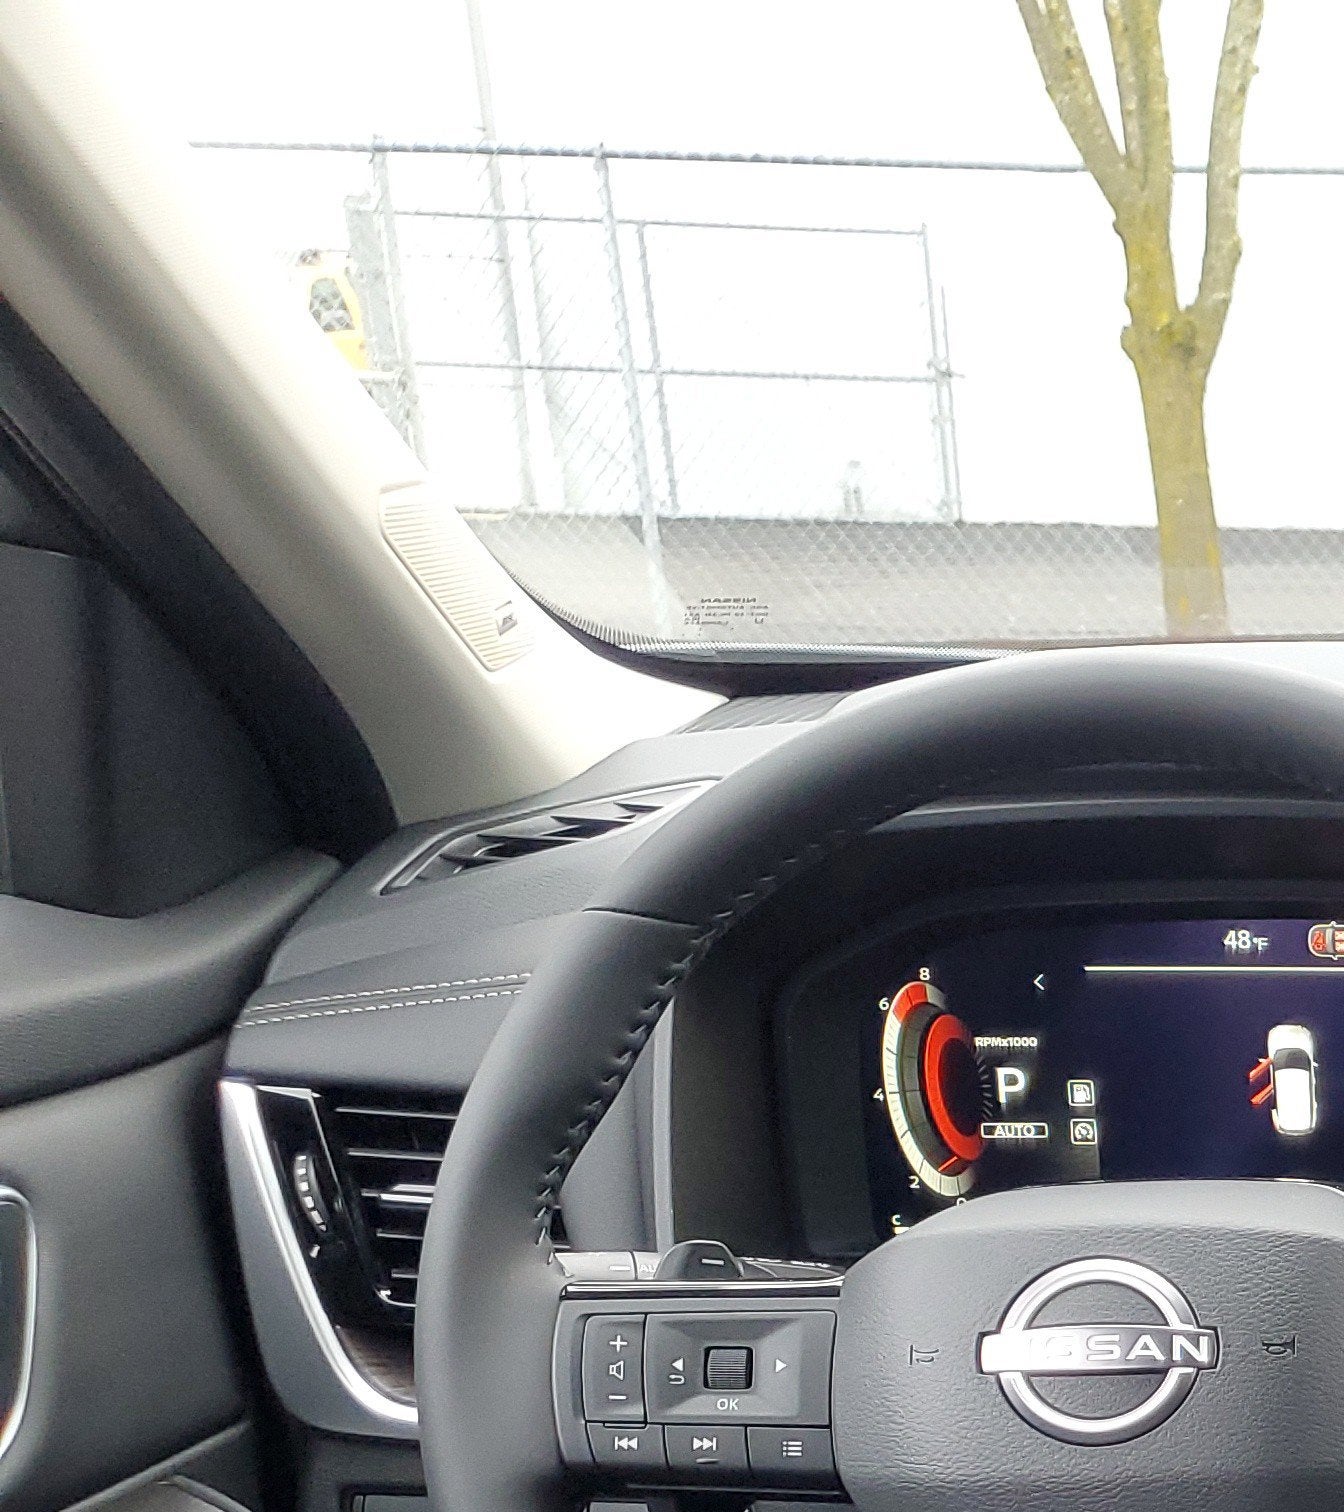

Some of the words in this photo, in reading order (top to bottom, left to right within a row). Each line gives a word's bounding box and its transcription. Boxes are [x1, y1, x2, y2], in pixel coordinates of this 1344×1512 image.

[920, 968, 929, 979] 8
[879, 998, 889, 1010] 6
[997, 1067, 1025, 1103] P
[873, 1088, 883, 1099] 4
[994, 1125, 1035, 1137] AUTO
[909, 1176, 920, 1188] 2
[717, 1399, 739, 1411] OK
